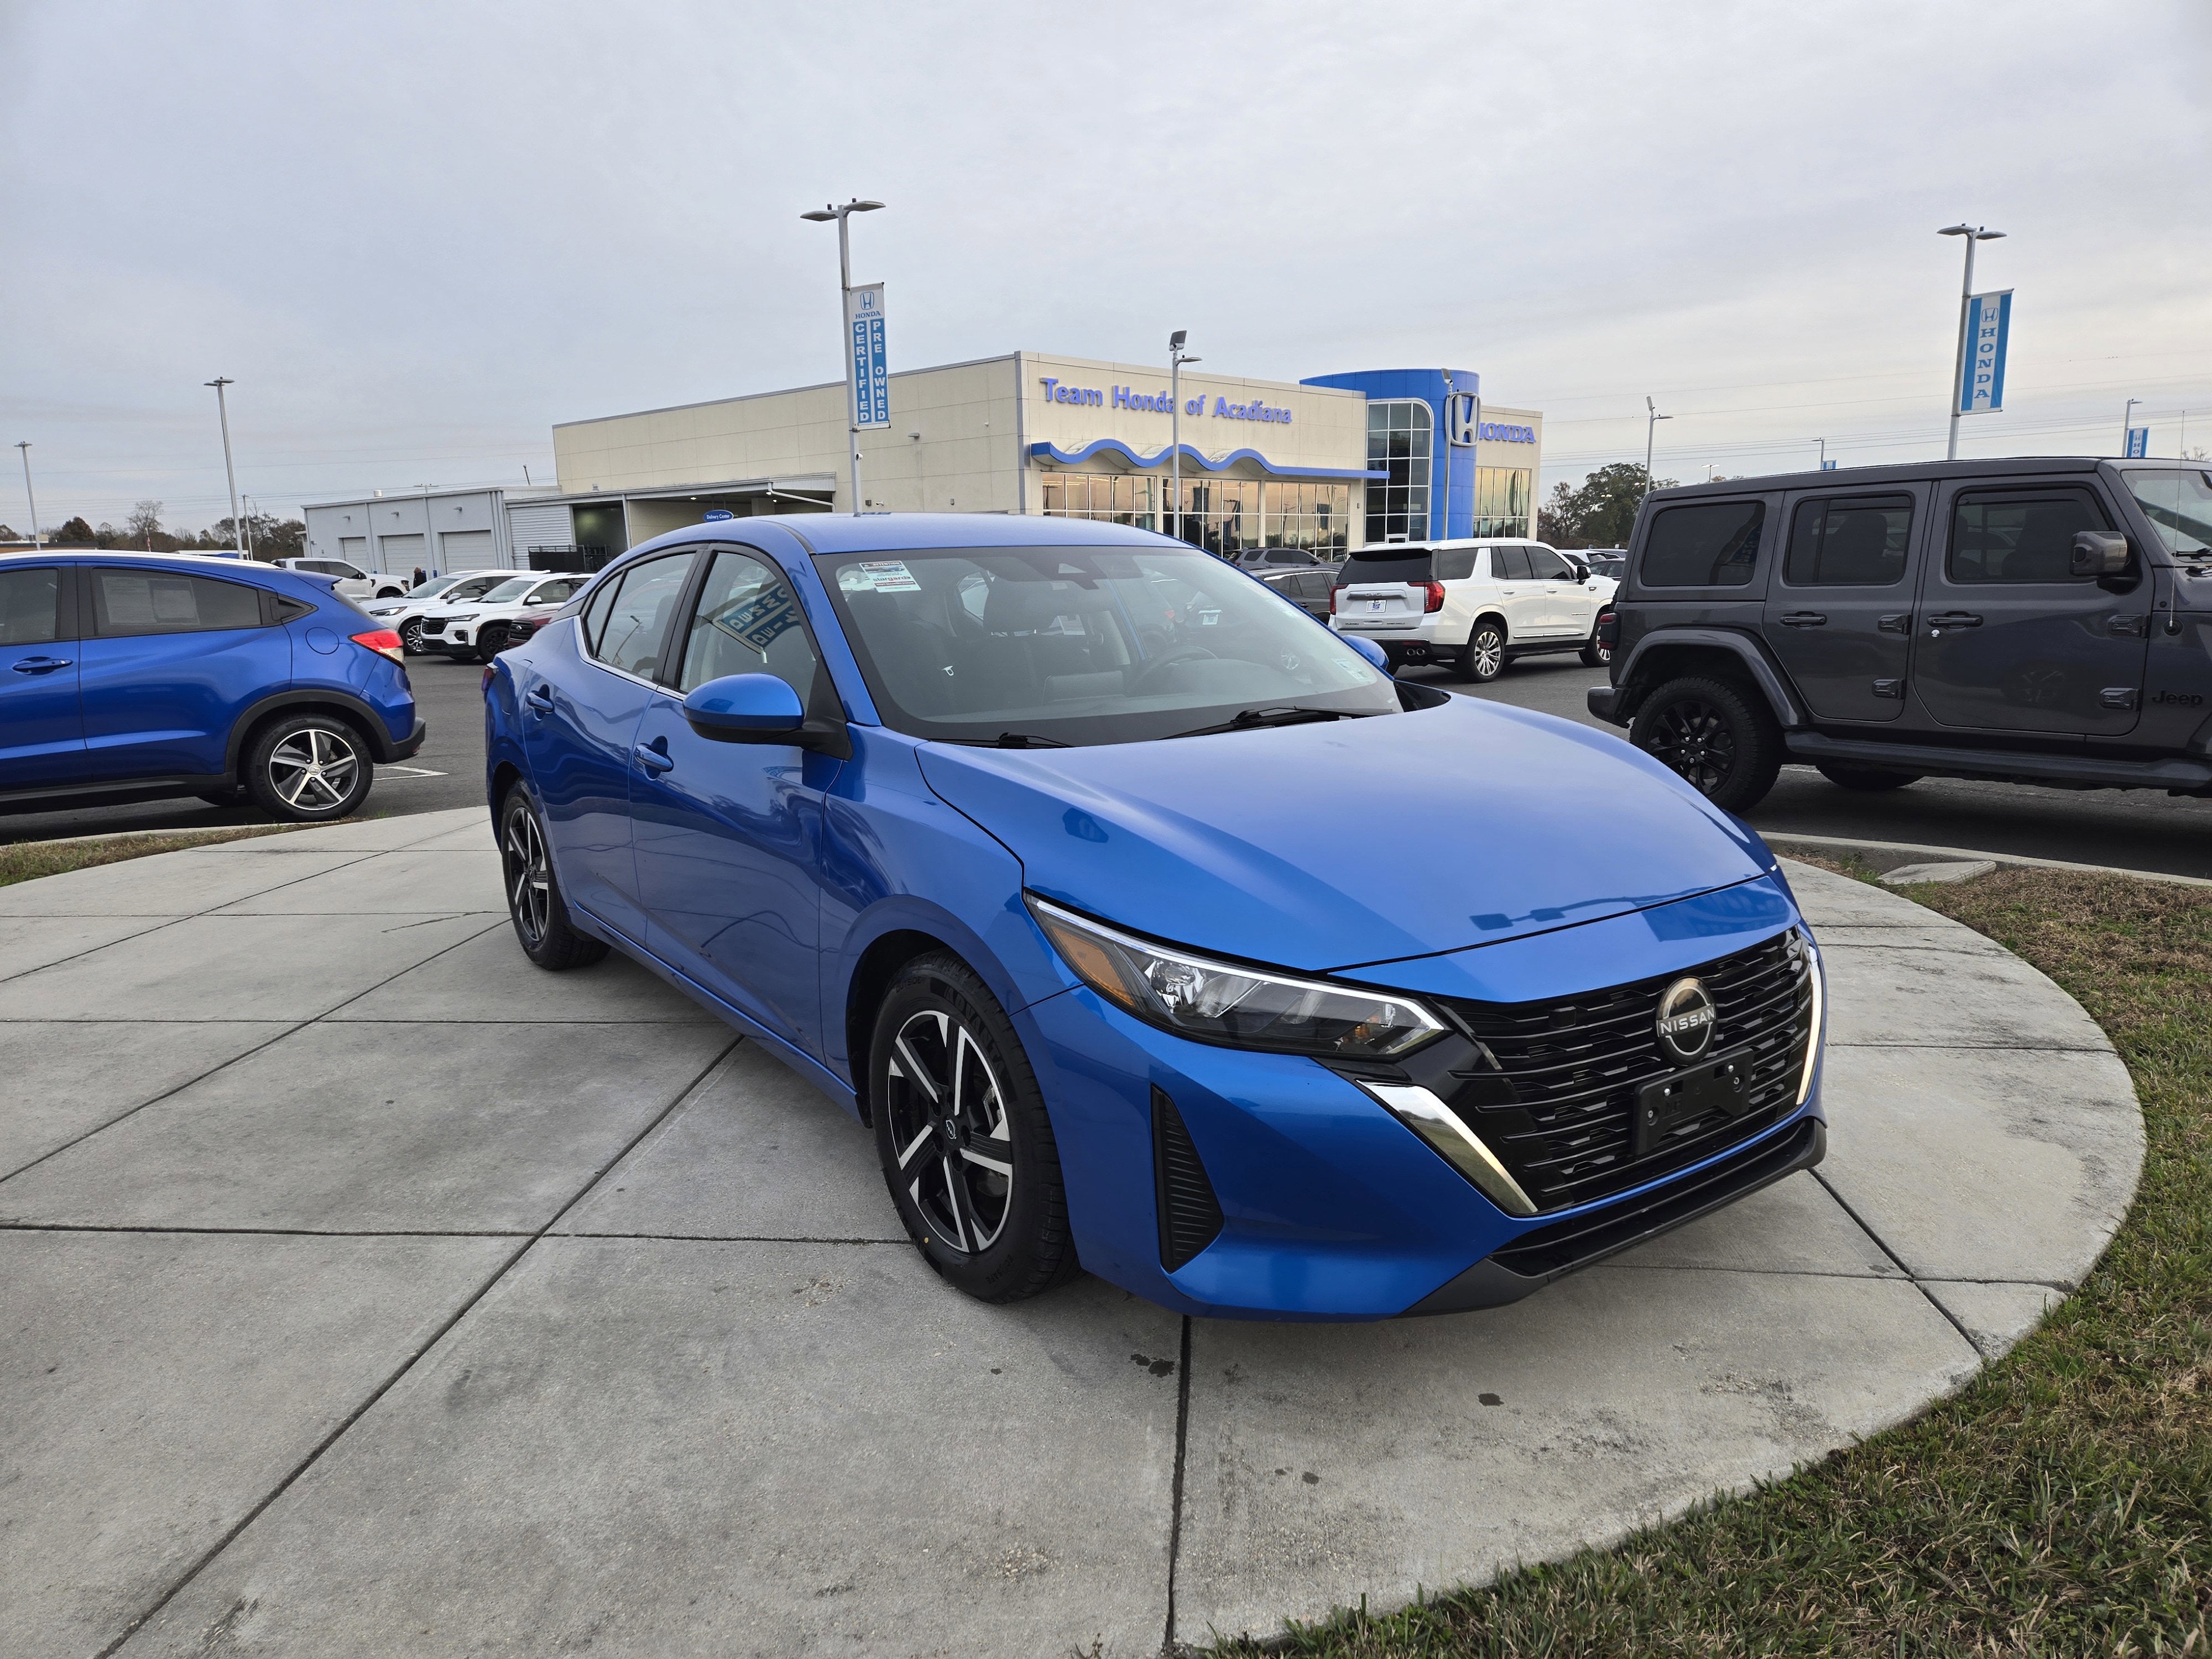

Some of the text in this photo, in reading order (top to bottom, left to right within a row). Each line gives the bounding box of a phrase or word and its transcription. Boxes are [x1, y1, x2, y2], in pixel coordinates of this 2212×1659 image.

[855, 311, 881, 319] HONDA
[855, 322, 869, 421] CERTIFIED
[873, 321, 886, 420] PRE OWNED
[1974, 327, 1996, 399] HONDA
[1040, 377, 1293, 424] Team Honda of Acadiana
[2152, 690, 2204, 708] Jeep
[1660, 1007, 1715, 1034] NISSAN
